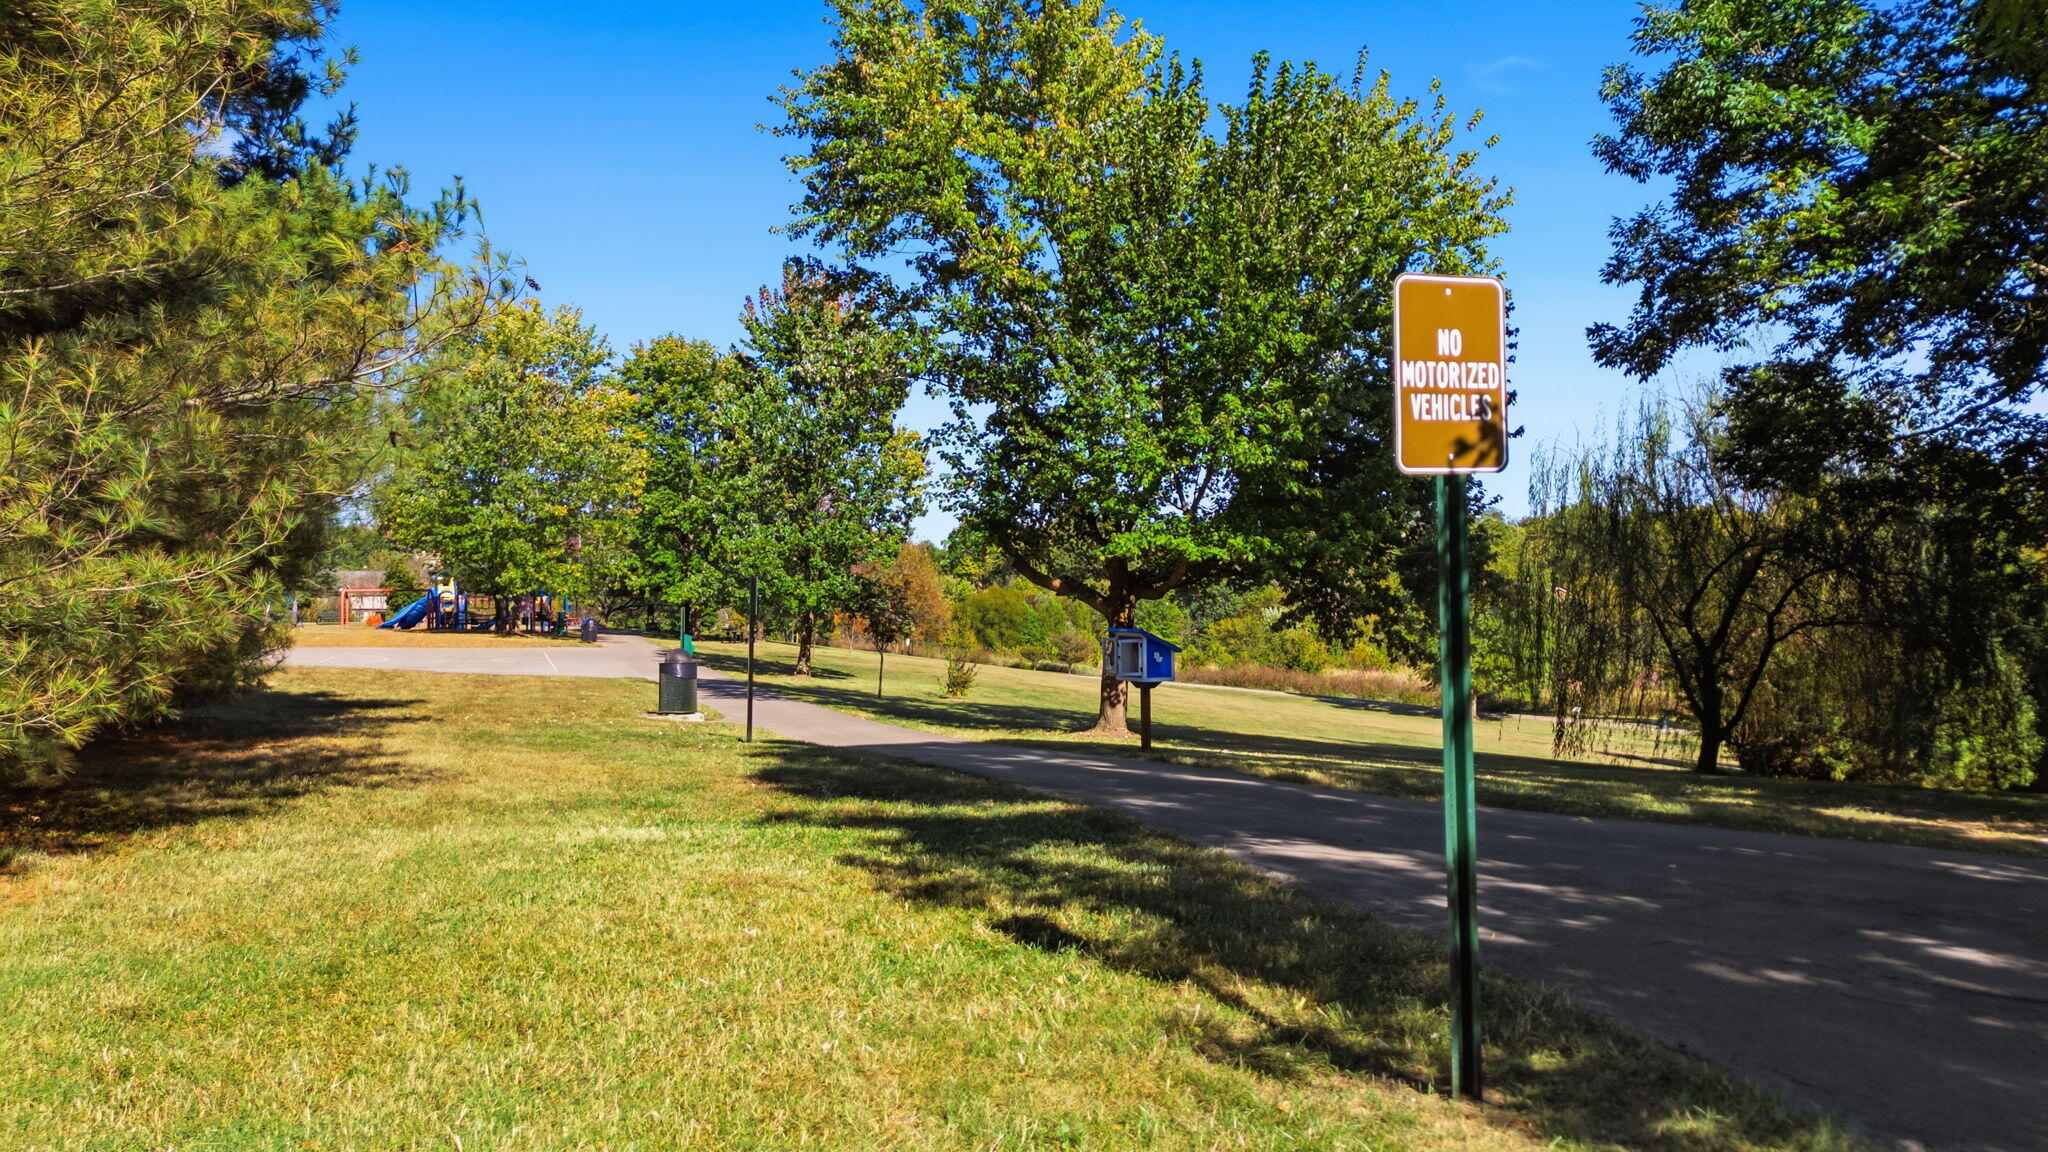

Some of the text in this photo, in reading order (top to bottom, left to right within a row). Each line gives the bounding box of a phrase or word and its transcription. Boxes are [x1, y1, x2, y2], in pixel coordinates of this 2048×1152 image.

[1437, 328, 1462, 357] NO
[1402, 360, 1500, 390] MOTORIZED
[1410, 393, 1493, 421] VEHICLES
